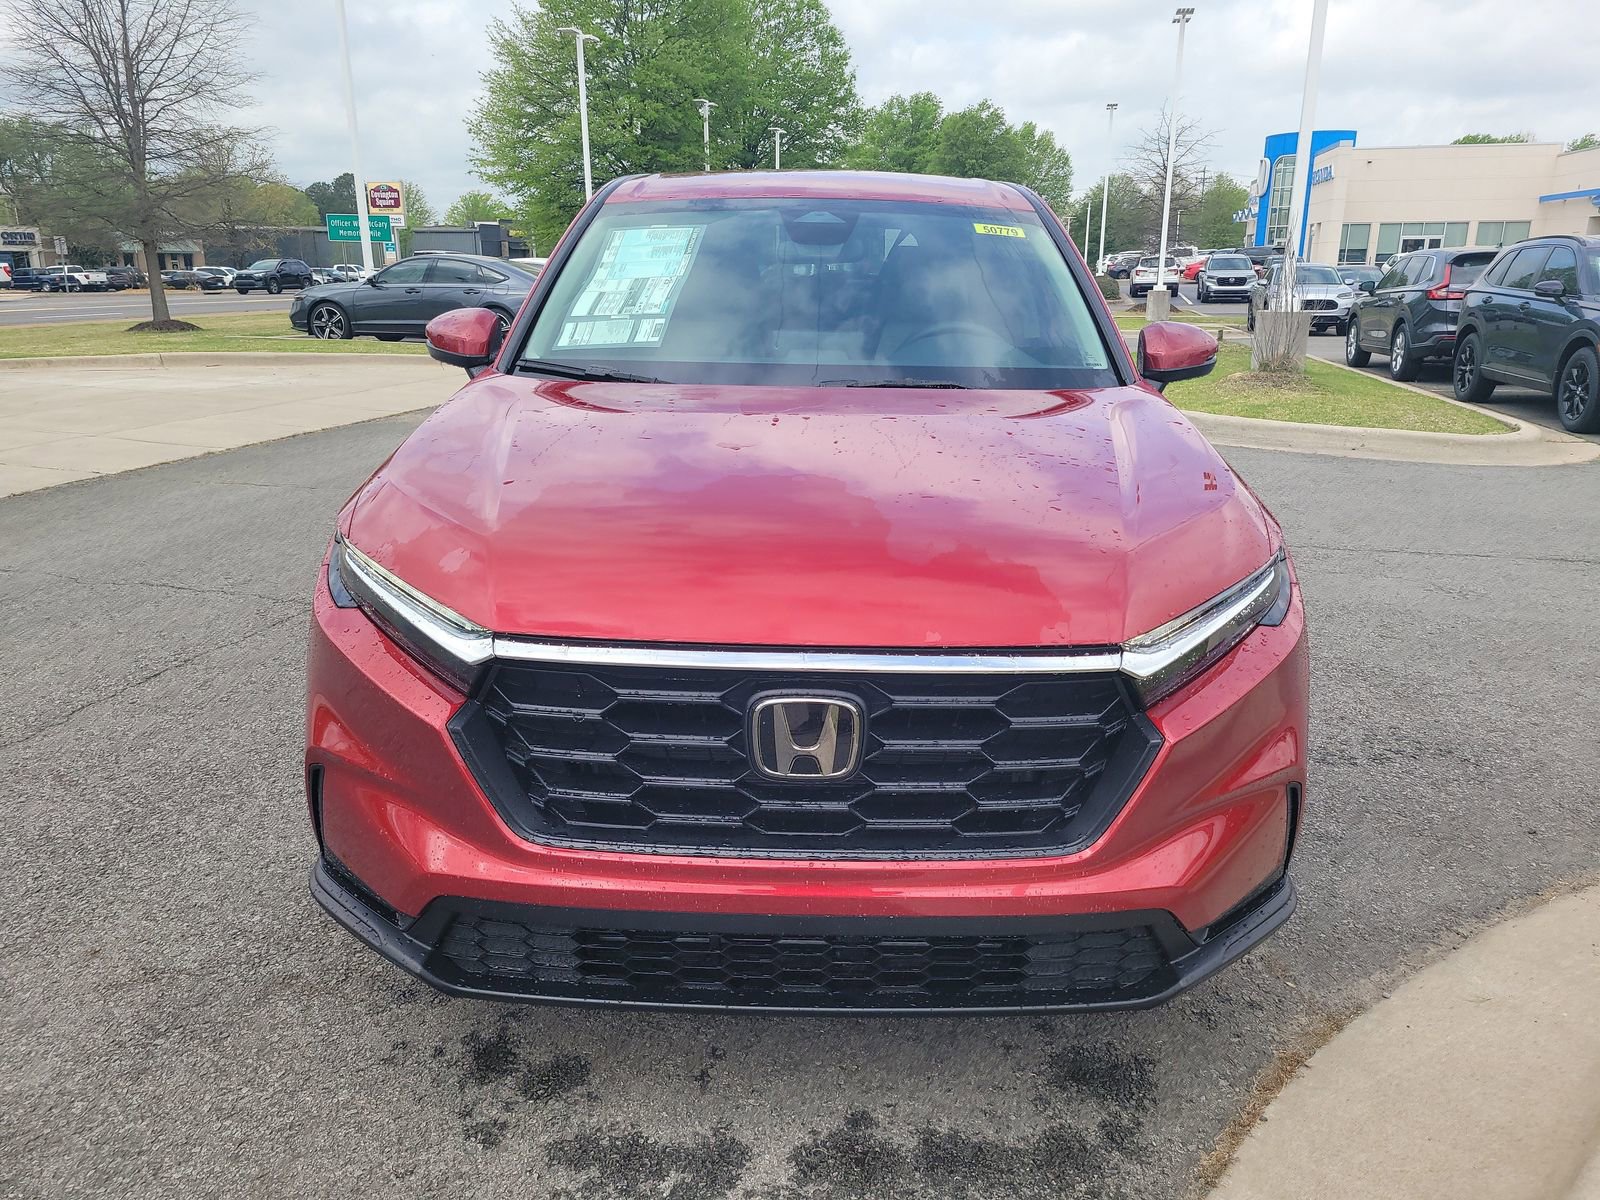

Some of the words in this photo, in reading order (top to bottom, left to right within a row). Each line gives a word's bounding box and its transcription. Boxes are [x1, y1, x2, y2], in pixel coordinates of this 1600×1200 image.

[371, 190, 399, 200] Covington
[376, 199, 395, 207] Square
[983, 226, 1018, 236] 50779
[1, 232, 35, 240] ORTHO
